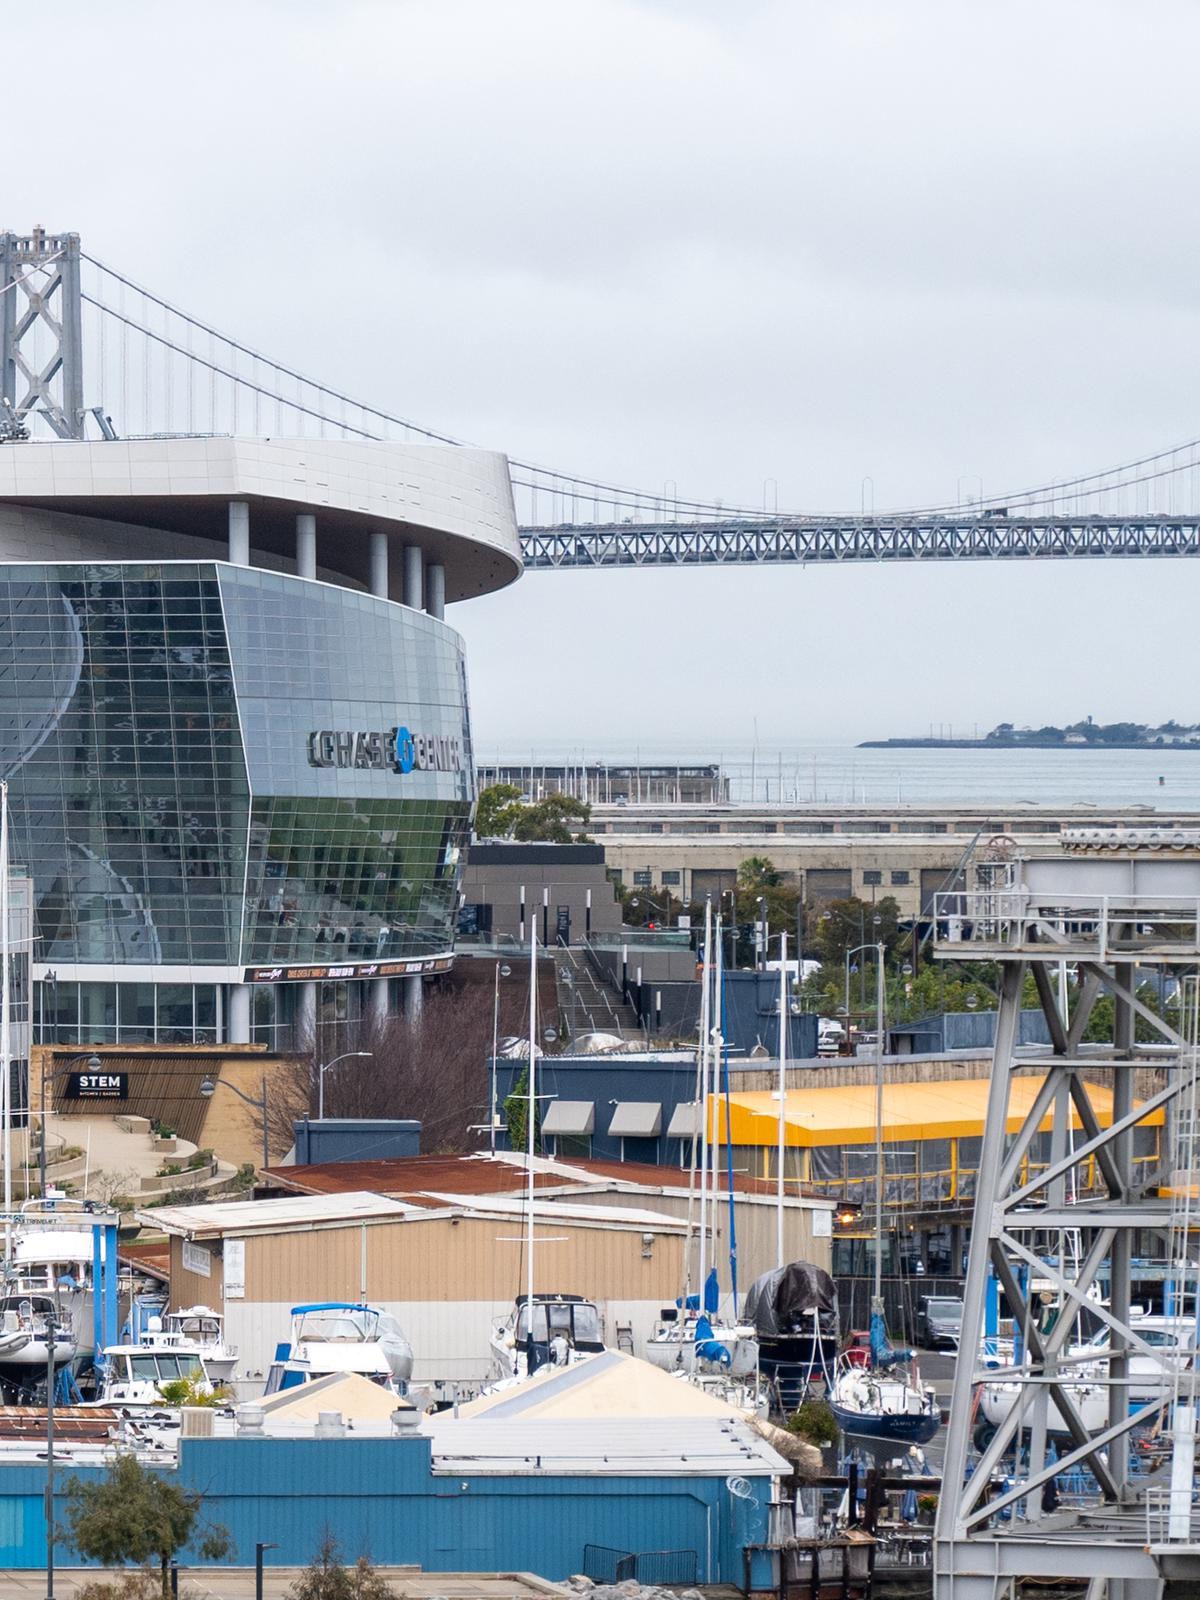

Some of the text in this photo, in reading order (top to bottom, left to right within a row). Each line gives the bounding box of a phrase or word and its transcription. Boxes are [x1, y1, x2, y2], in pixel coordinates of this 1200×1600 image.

[308, 731, 461, 771] CHASE CENTER
[79, 1076, 120, 1087] STEM
